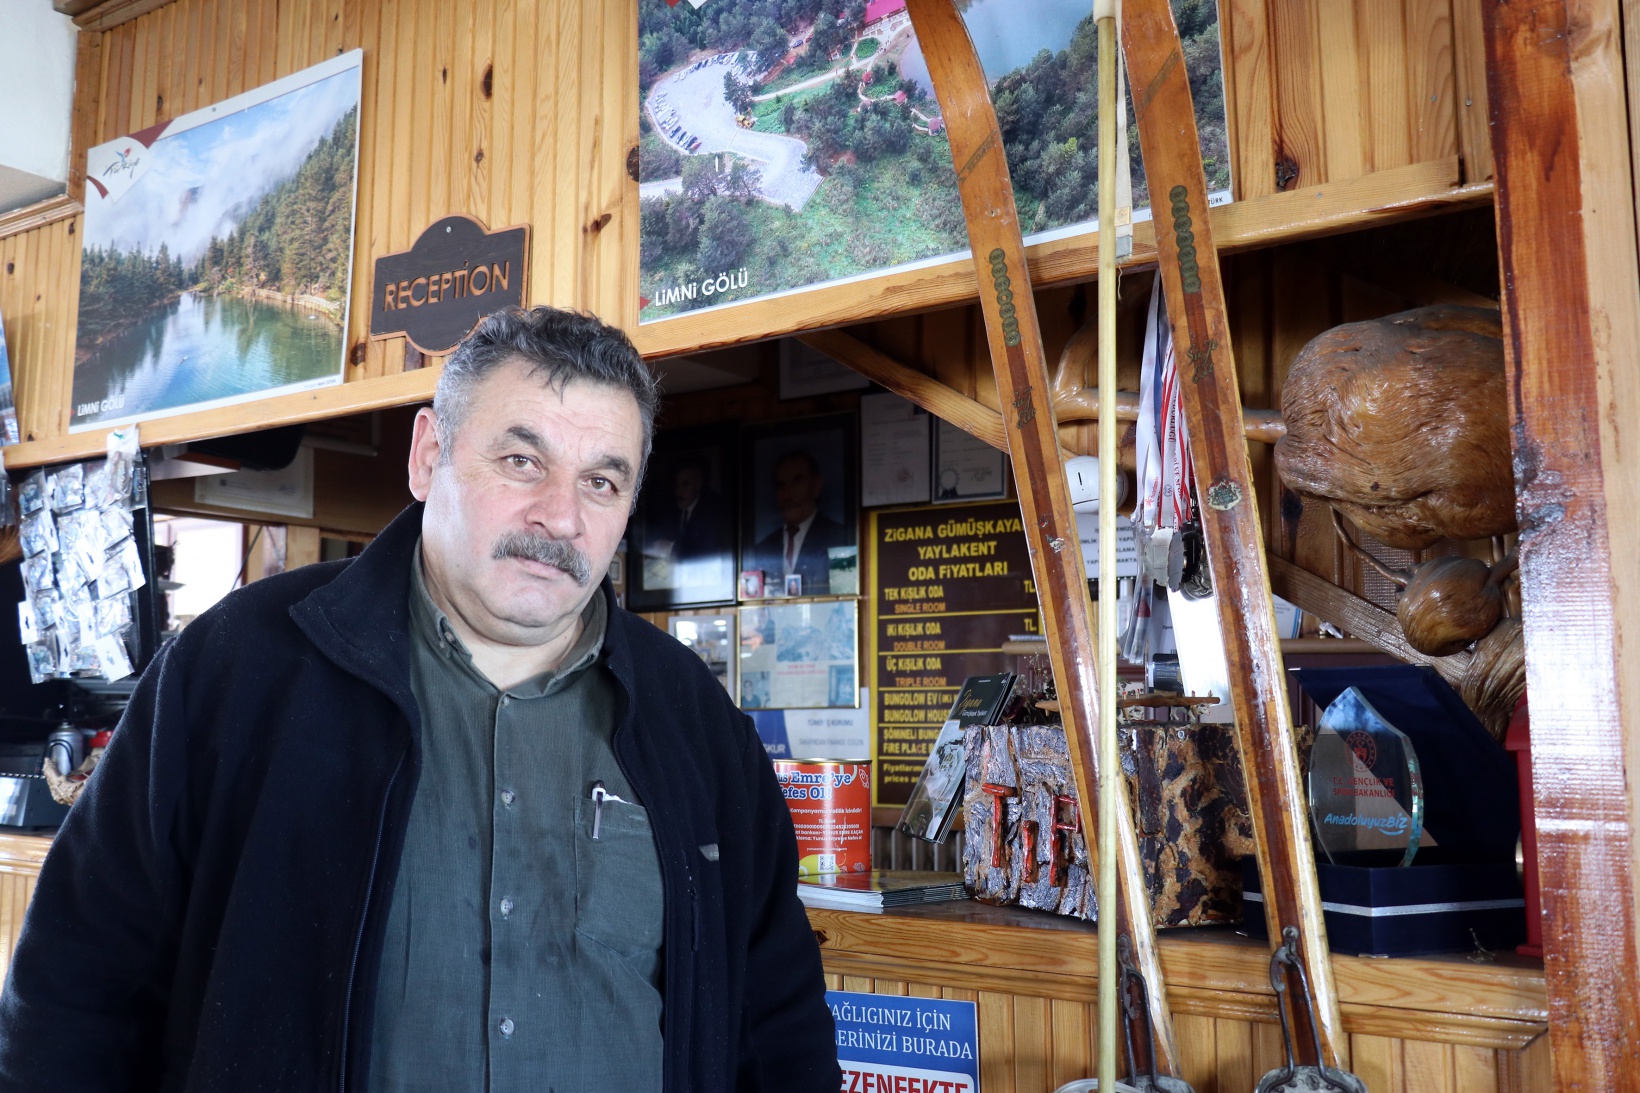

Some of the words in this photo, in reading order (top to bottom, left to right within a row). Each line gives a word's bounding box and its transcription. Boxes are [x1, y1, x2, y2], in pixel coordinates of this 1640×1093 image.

[701, 267, 748, 296] GÖLÜ
[938, 518, 1025, 538] GÜMÜŞKAYA
[918, 541, 997, 560] YAYLAKENT
[908, 566, 936, 581] ODA
[884, 588, 899, 601] TEK
[928, 585, 944, 598] ODA
[894, 603, 921, 614] SINGLE
[922, 602, 946, 613] ROOM
[925, 621, 941, 635] ODA
[893, 641, 922, 652] DOUBLE
[923, 640, 946, 651] ROOM
[886, 656, 897, 673] ÜÇ
[925, 656, 941, 670] ODA
[896, 677, 922, 688] TRIPLE
[923, 676, 947, 687] ROOM
[883, 692, 926, 706] BUNGOLOW
[883, 709, 926, 722] BUNGOLOW
[901, 742, 927, 754] PLACE
[883, 774, 909, 784] prices
[780, 785, 807, 800] efes
[827, 1001, 912, 1027] AĞLIGINIZ
[917, 1008, 950, 1033] İÇİN
[836, 1029, 897, 1052] ERİNİZİ
[902, 1036, 973, 1059] BURADA
